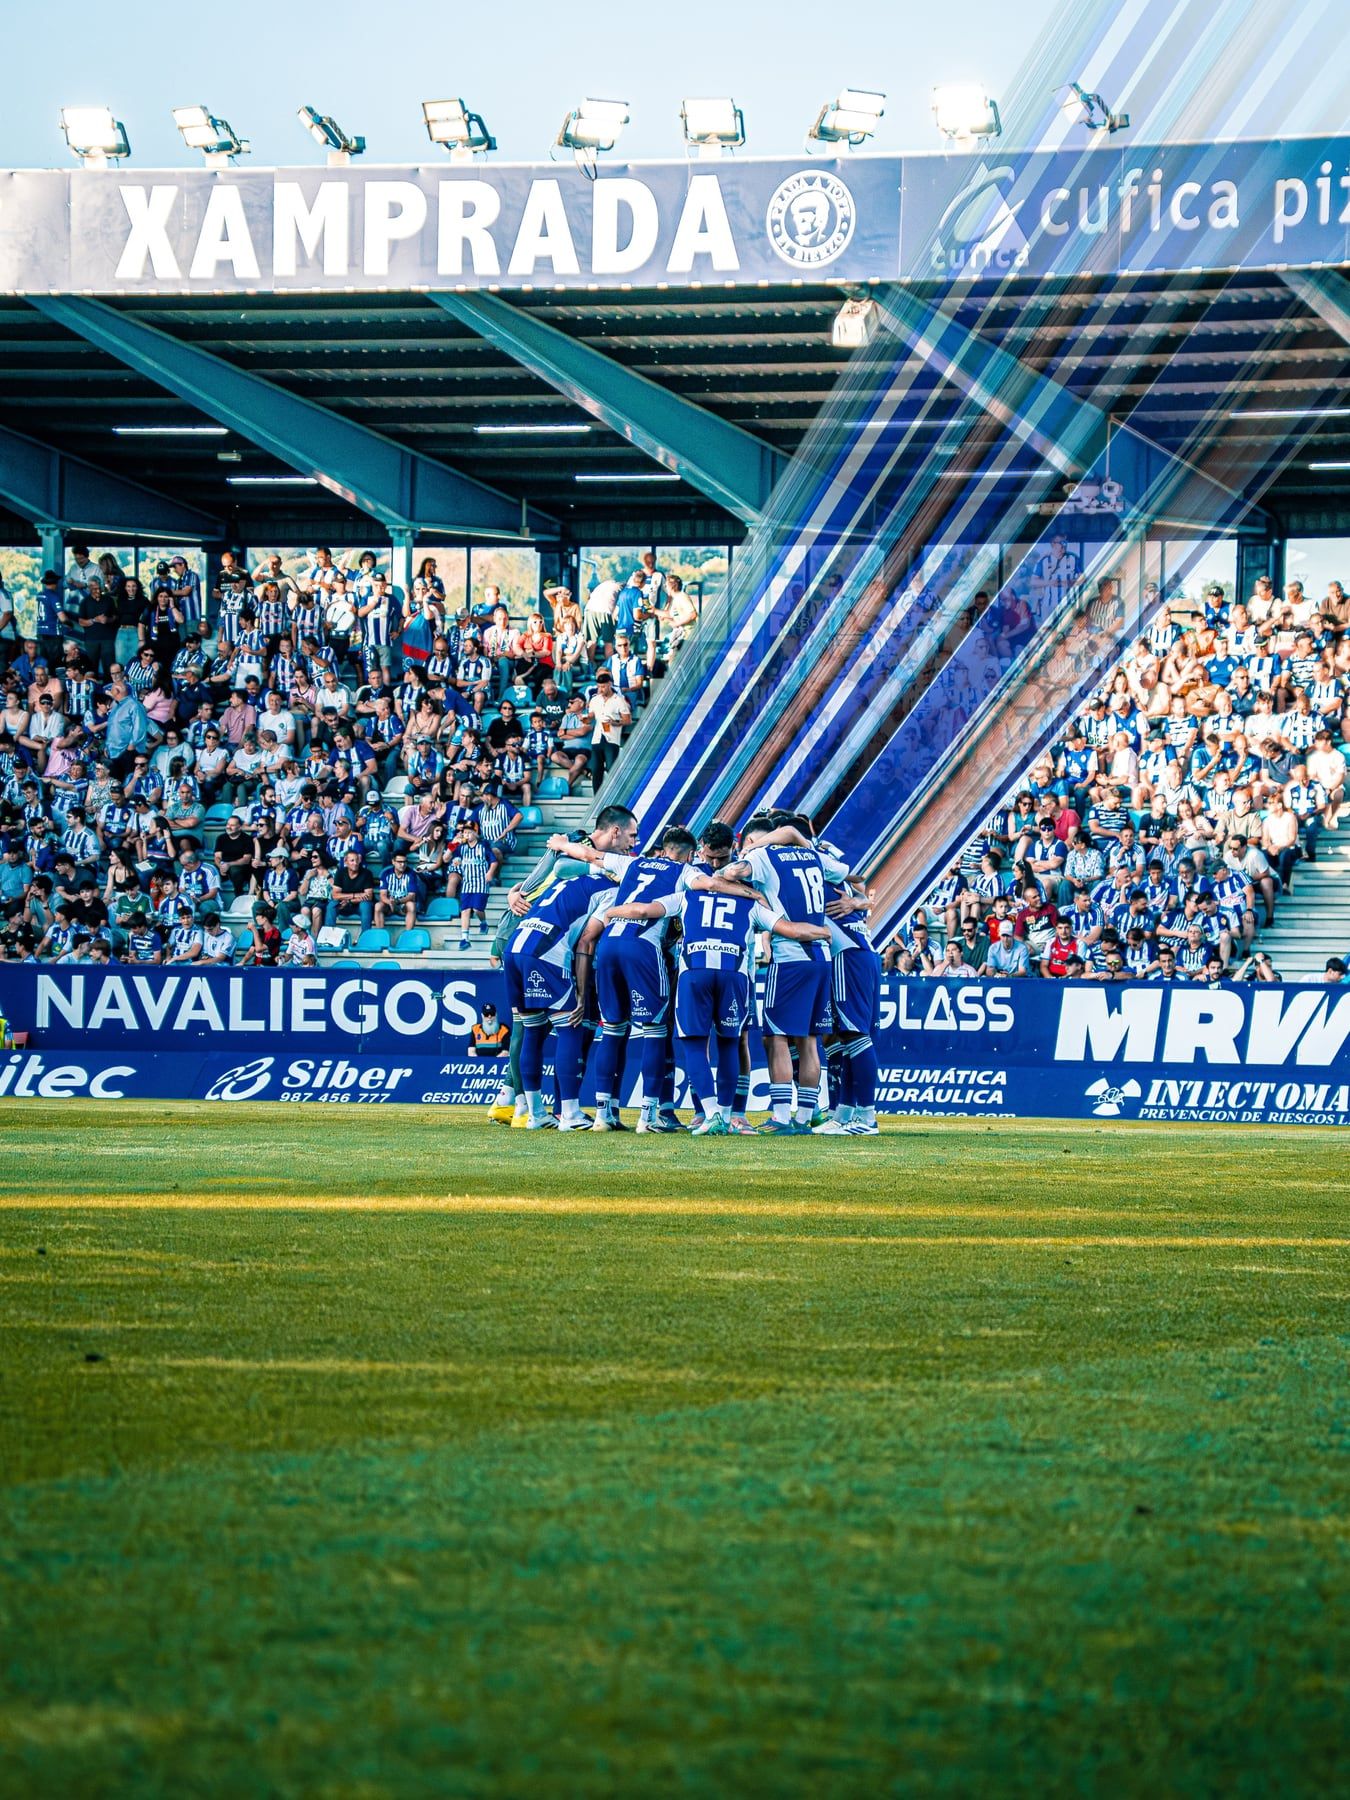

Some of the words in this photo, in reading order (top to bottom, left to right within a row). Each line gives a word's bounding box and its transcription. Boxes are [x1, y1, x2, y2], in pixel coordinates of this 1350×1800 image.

[1041, 168, 1240, 236] cufica
[114, 173, 740, 279] XAMPRADA
[623, 872, 656, 905] 7
[792, 866, 824, 914] 18
[698, 895, 737, 931] 12
[697, 944, 739, 954] VALCARCE
[36, 974, 478, 1036] NAVALIEGOS
[1054, 987, 1350, 1066] MRW
[282, 1059, 413, 1089] Siber
[440, 1063, 484, 1075] AYUDA
[487, 1064, 498, 1075] A
[461, 1078, 505, 1090] LIMPIE
[279, 1092, 313, 1102] 987
[318, 1093, 351, 1103] 456
[357, 1093, 391, 1103] 777
[421, 1090, 483, 1104] GESTIÓN
[1138, 1108, 1239, 1122] PREVENCION
[1241, 1111, 1262, 1122] DE
[1268, 1112, 1336, 1125] RIESGOS
